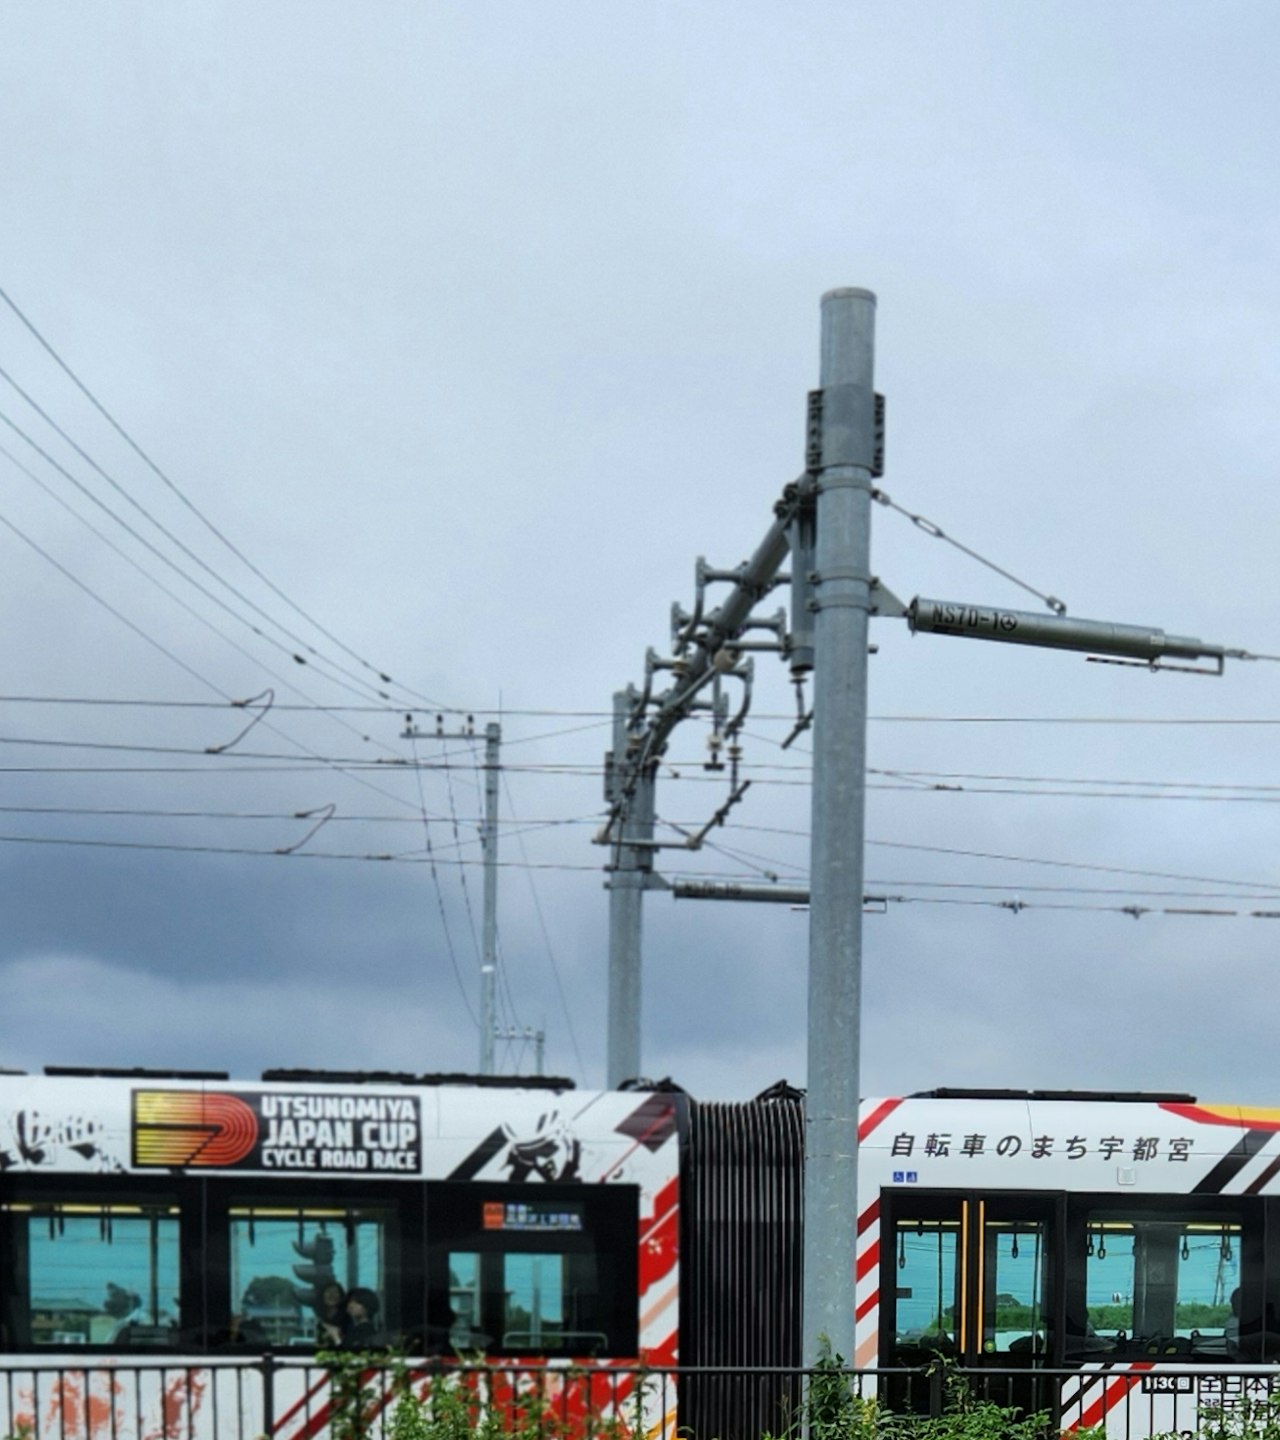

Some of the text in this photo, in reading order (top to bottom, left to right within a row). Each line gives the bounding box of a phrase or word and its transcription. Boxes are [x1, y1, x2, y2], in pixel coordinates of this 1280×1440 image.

[261, 1095, 416, 1121] UTSUNOMIYA
[261, 1119, 418, 1149] JAPAN CUP
[891, 1132, 1195, 1162] 自転車のまち宇都宮
[261, 1148, 418, 1170] CYCLE ROAD RACE
